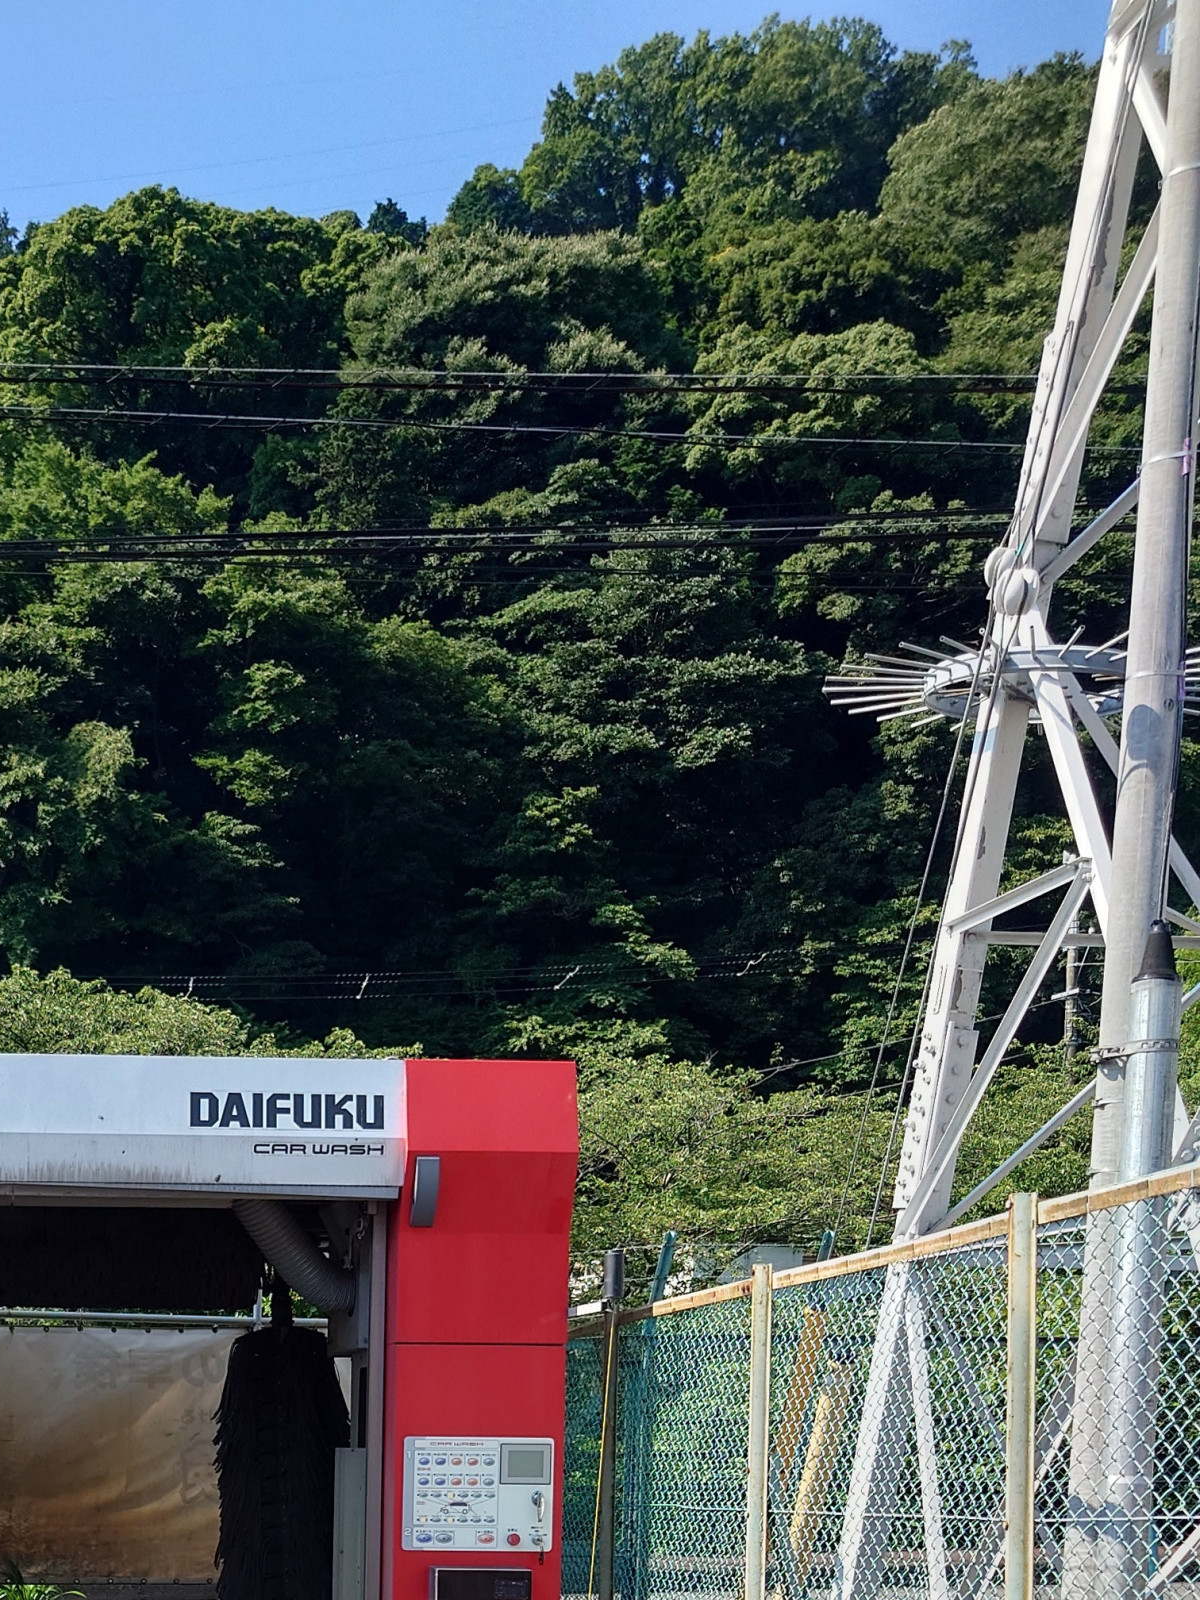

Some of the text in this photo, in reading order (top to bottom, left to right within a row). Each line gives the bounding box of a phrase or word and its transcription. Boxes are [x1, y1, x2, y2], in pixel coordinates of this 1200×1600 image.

[190, 1092, 384, 1129] DAIFUKU
[253, 1144, 384, 1155] CAR WASH
